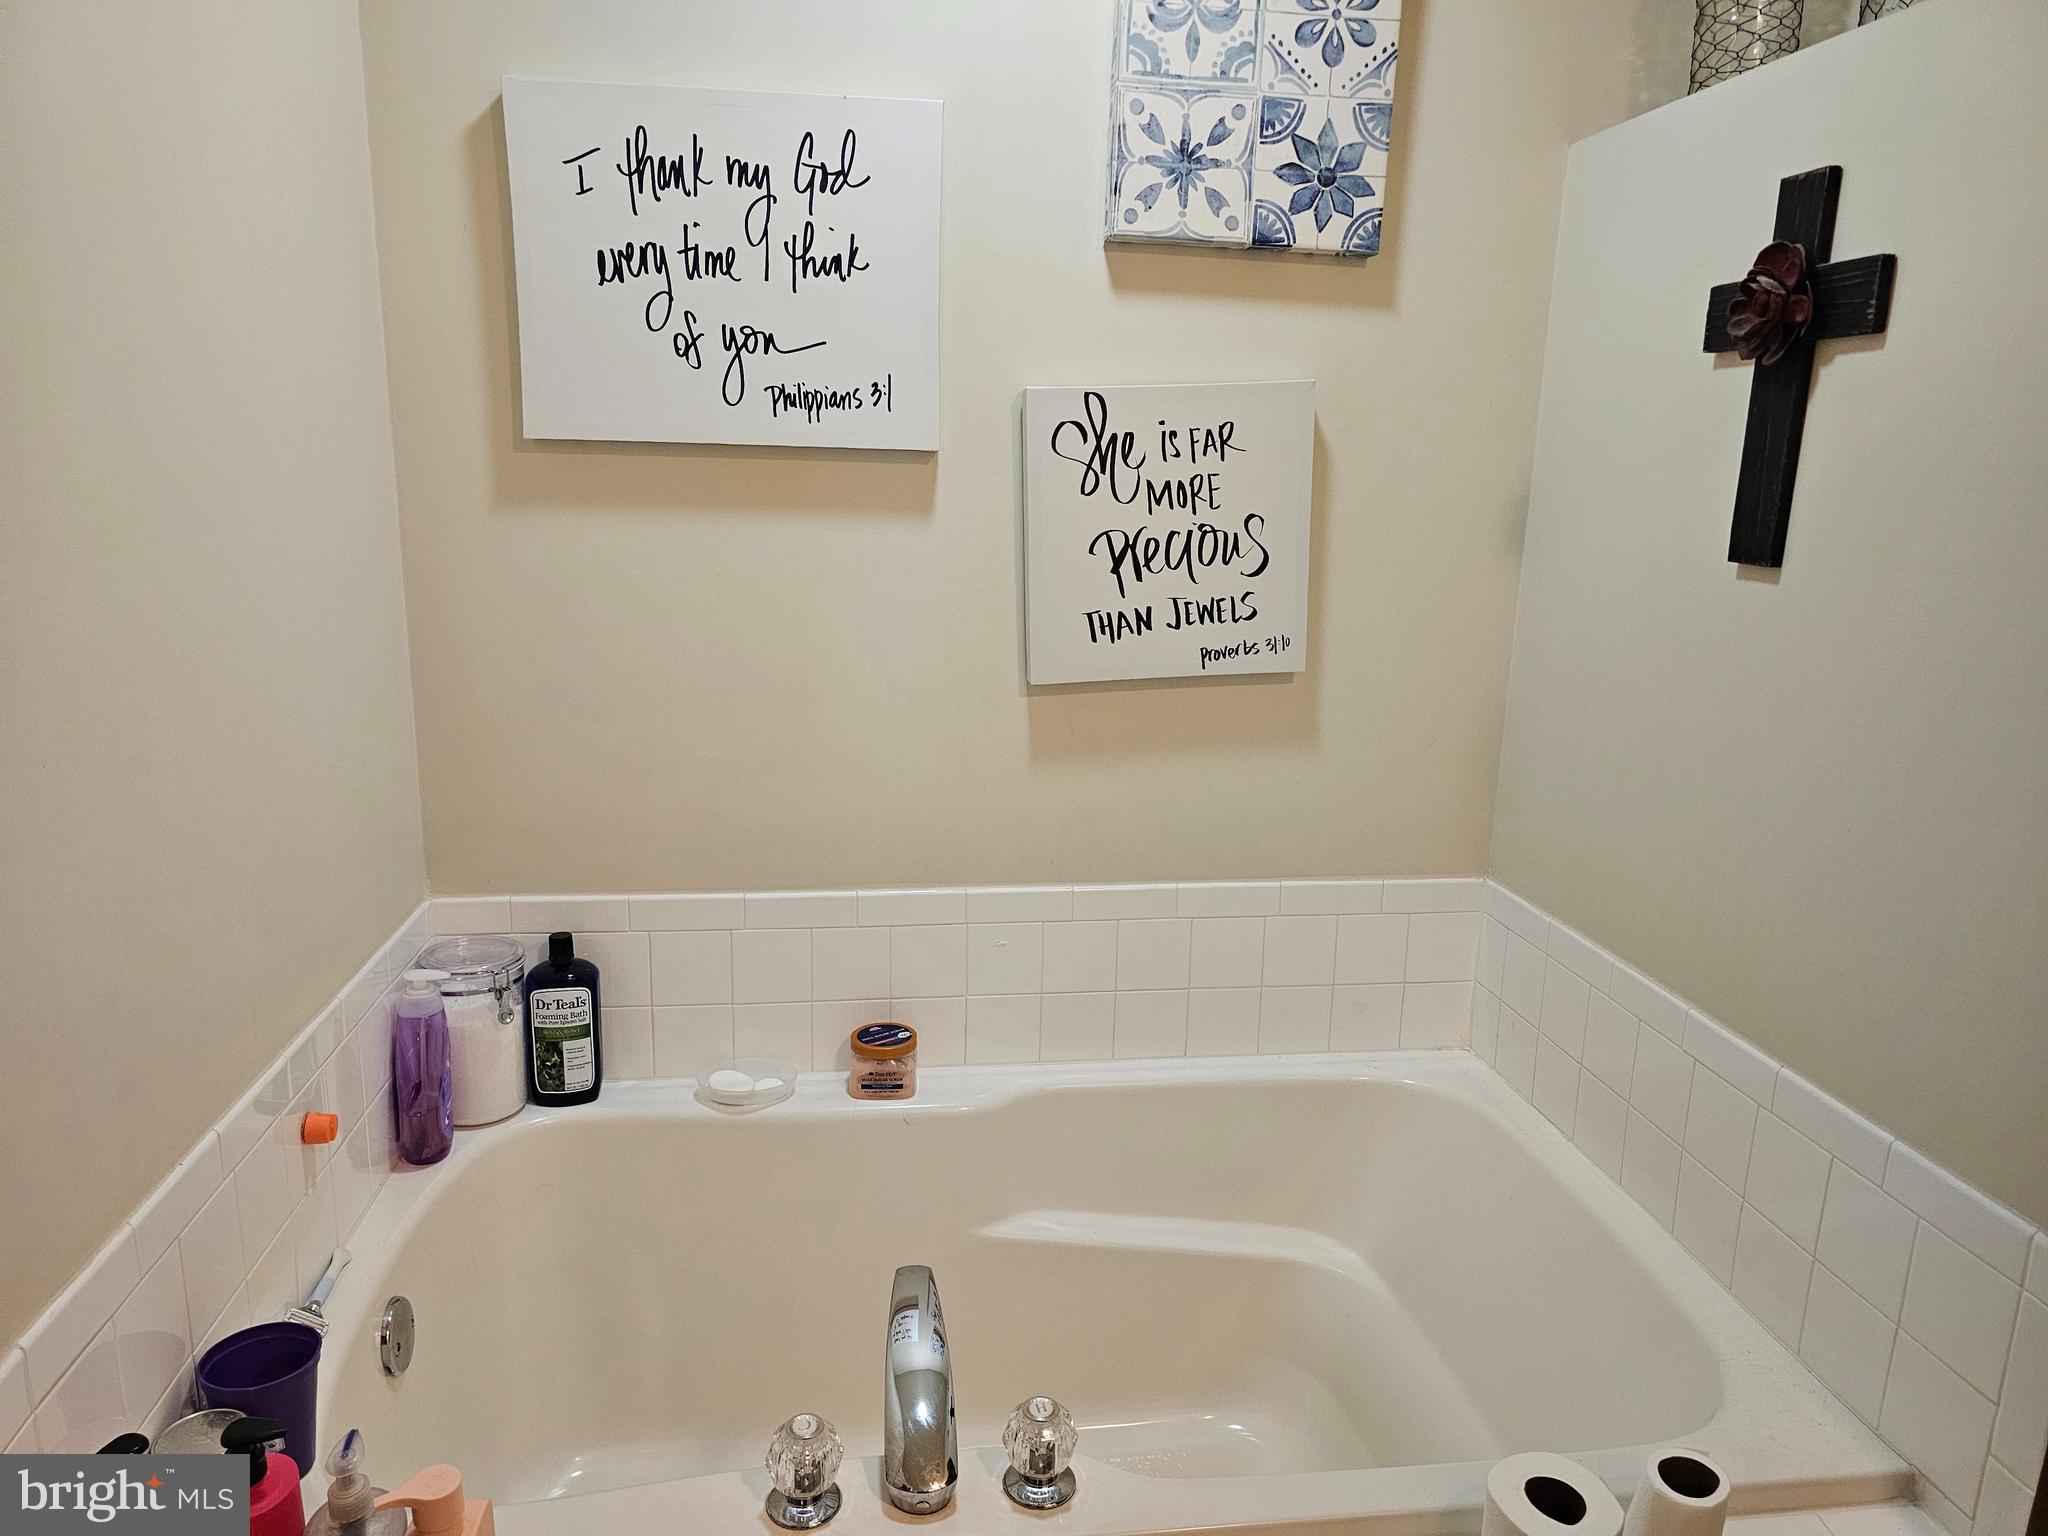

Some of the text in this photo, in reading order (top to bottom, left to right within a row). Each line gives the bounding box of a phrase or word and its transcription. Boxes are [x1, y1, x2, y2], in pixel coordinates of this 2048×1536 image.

[562, 125, 871, 226] I thank my God
[597, 241, 675, 332] every
[676, 222, 742, 282] time
[784, 221, 870, 294] think
[674, 310, 827, 407] of you
[871, 373, 892, 413] 3:1
[1051, 391, 1147, 505] She
[1189, 421, 1247, 464] FAR
[1146, 473, 1222, 516] MORE
[1082, 591, 1259, 644] THAN JEWELS
[535, 996, 587, 1010] Dr Teal's
[535, 1010, 588, 1020] Foaming Bath
